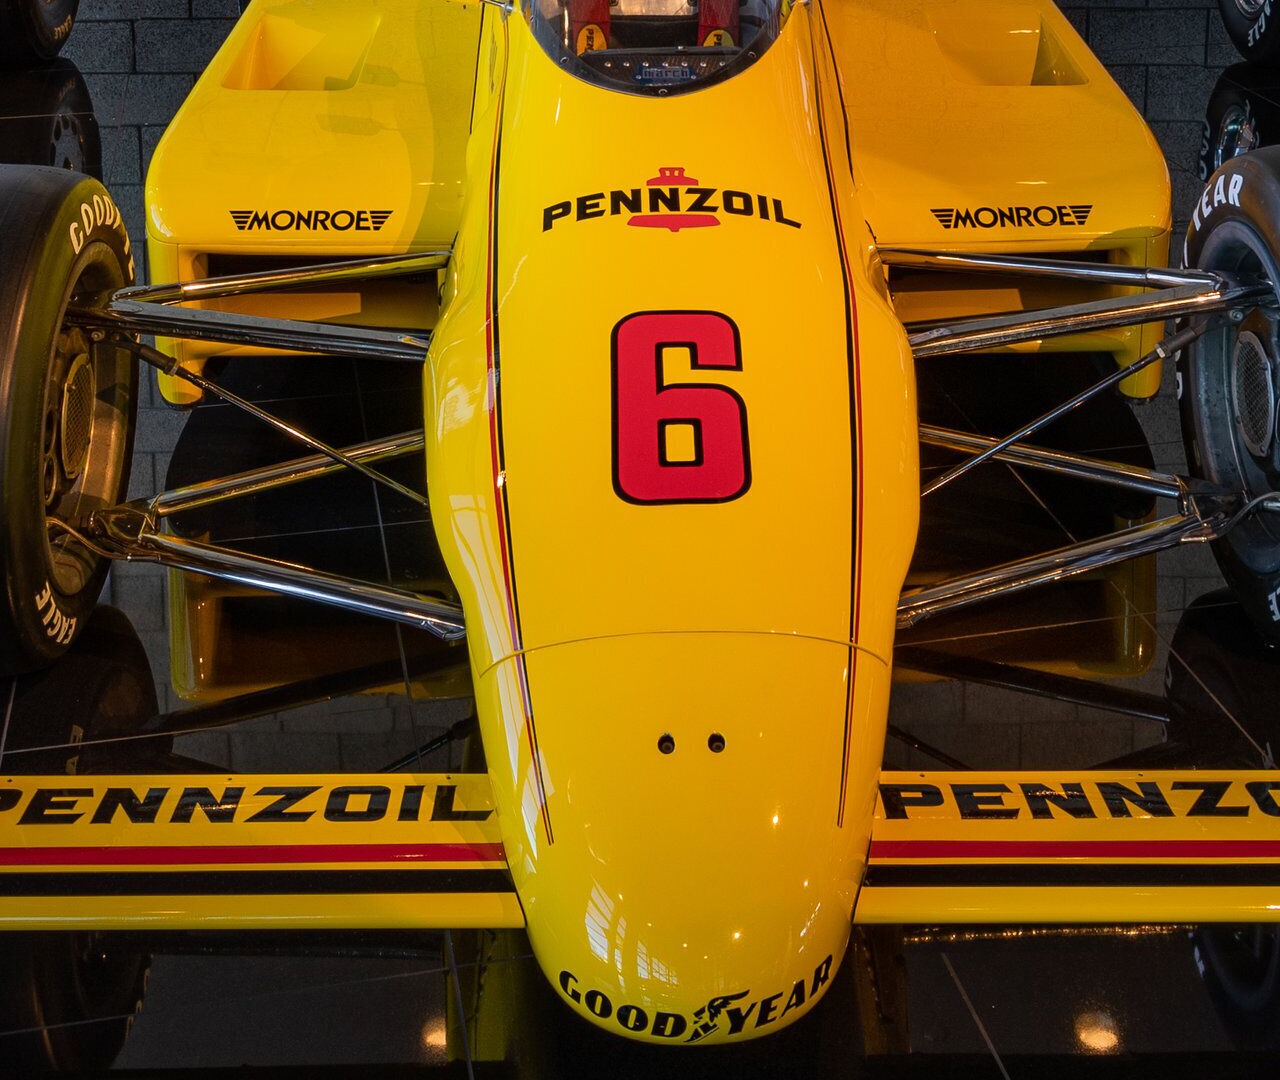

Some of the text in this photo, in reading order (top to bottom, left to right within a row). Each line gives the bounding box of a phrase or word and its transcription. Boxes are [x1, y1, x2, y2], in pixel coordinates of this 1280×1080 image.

[248, 210, 373, 232] MONROE
[541, 186, 803, 233] PENNZOIL
[951, 205, 1073, 229] MONROE
[610, 309, 752, 506] 6
[34, 580, 78, 645] EAGLE
[558, 953, 833, 1045] GOODYEAR
